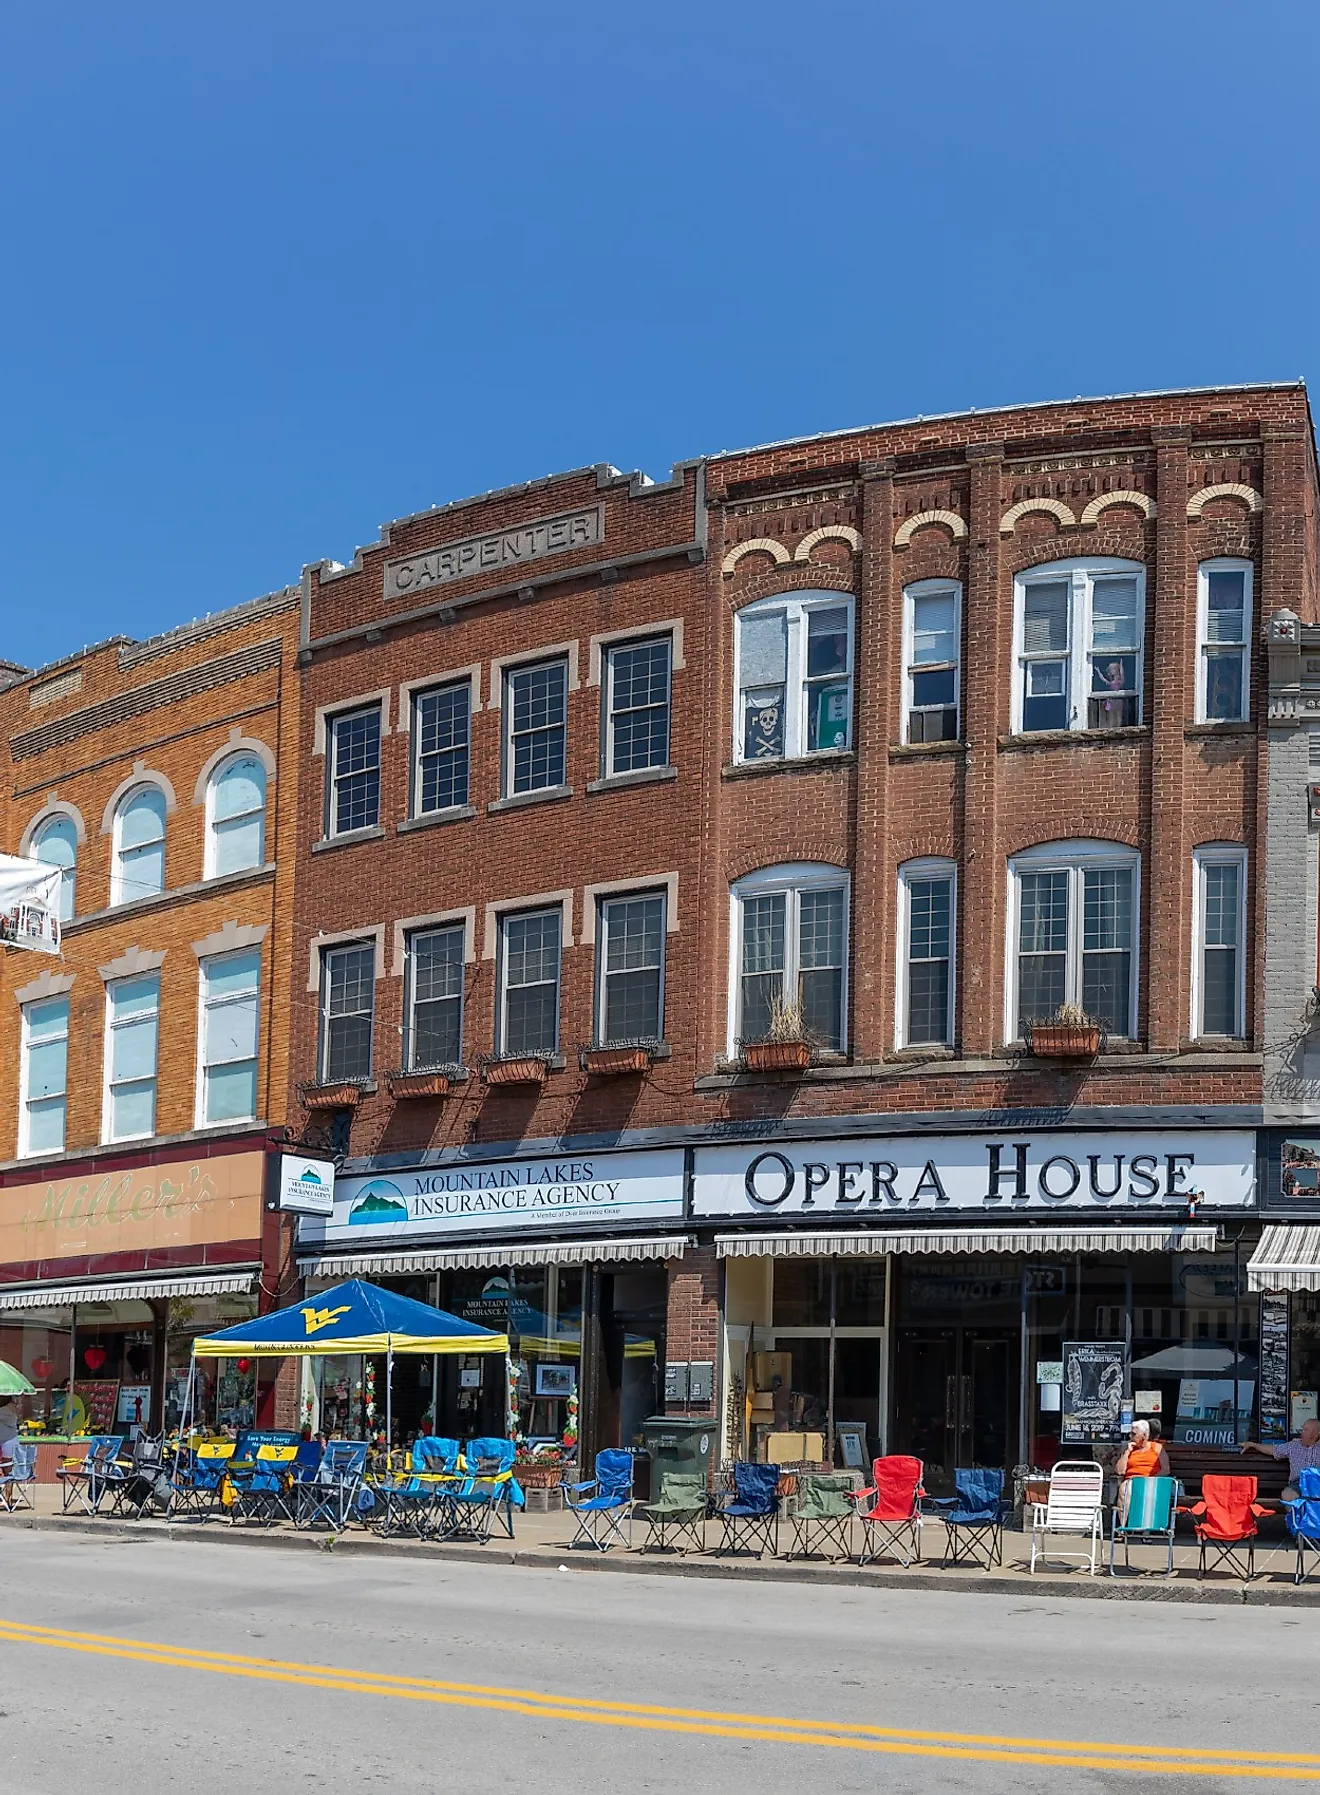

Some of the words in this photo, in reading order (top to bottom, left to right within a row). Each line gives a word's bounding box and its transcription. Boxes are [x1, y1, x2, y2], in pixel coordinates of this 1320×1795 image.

[395, 517, 591, 591] CARPENTER
[414, 1168, 520, 1196] MOUNTAIN
[526, 1162, 594, 1186] LAKES
[20, 1165, 218, 1233] Miller's
[413, 1188, 527, 1217] INSURANCE
[531, 1182, 621, 1207] AGENCY
[462, 1308, 502, 1317] INSURANCE
[467, 1300, 504, 1308] MOUNTAIN
[1185, 1429, 1235, 1445] COMING
